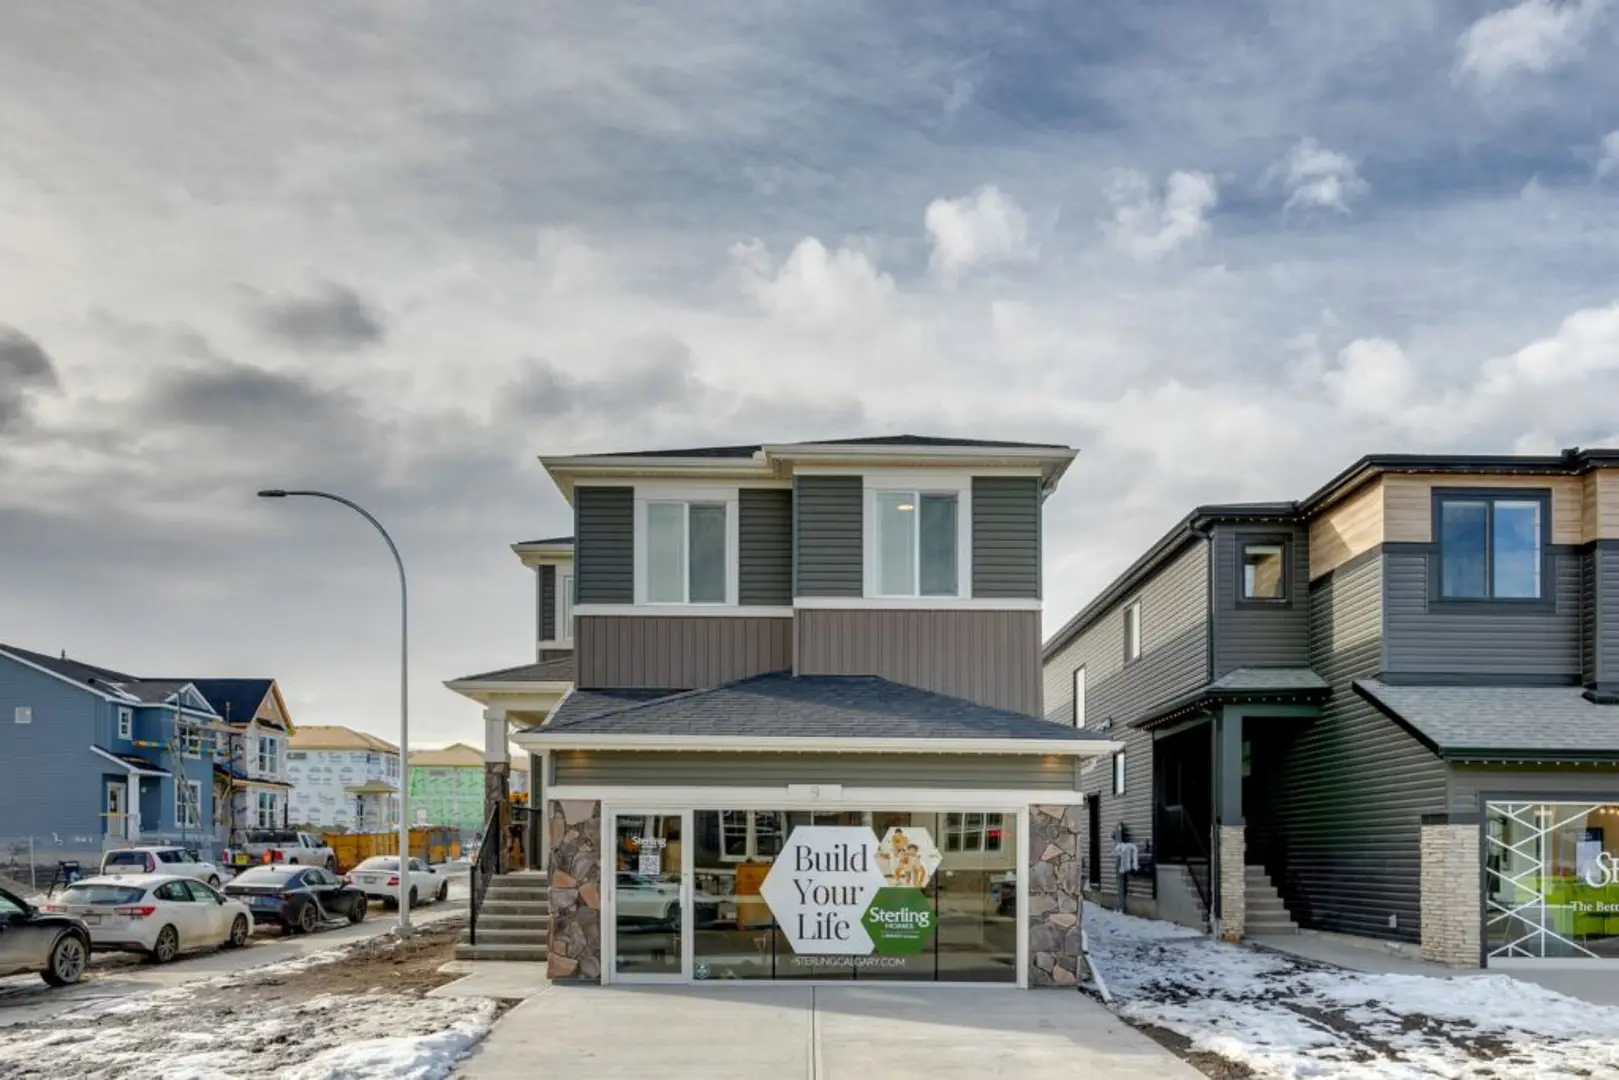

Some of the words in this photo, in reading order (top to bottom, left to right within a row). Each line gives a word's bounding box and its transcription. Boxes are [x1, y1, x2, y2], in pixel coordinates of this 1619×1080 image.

[795, 844, 868, 871] Build
[793, 879, 864, 905] Your
[870, 907, 930, 928] Sterling
[1570, 901, 1593, 911] The
[797, 912, 850, 941] Life
[796, 956, 906, 967] STERLINGCALGARY.COM
